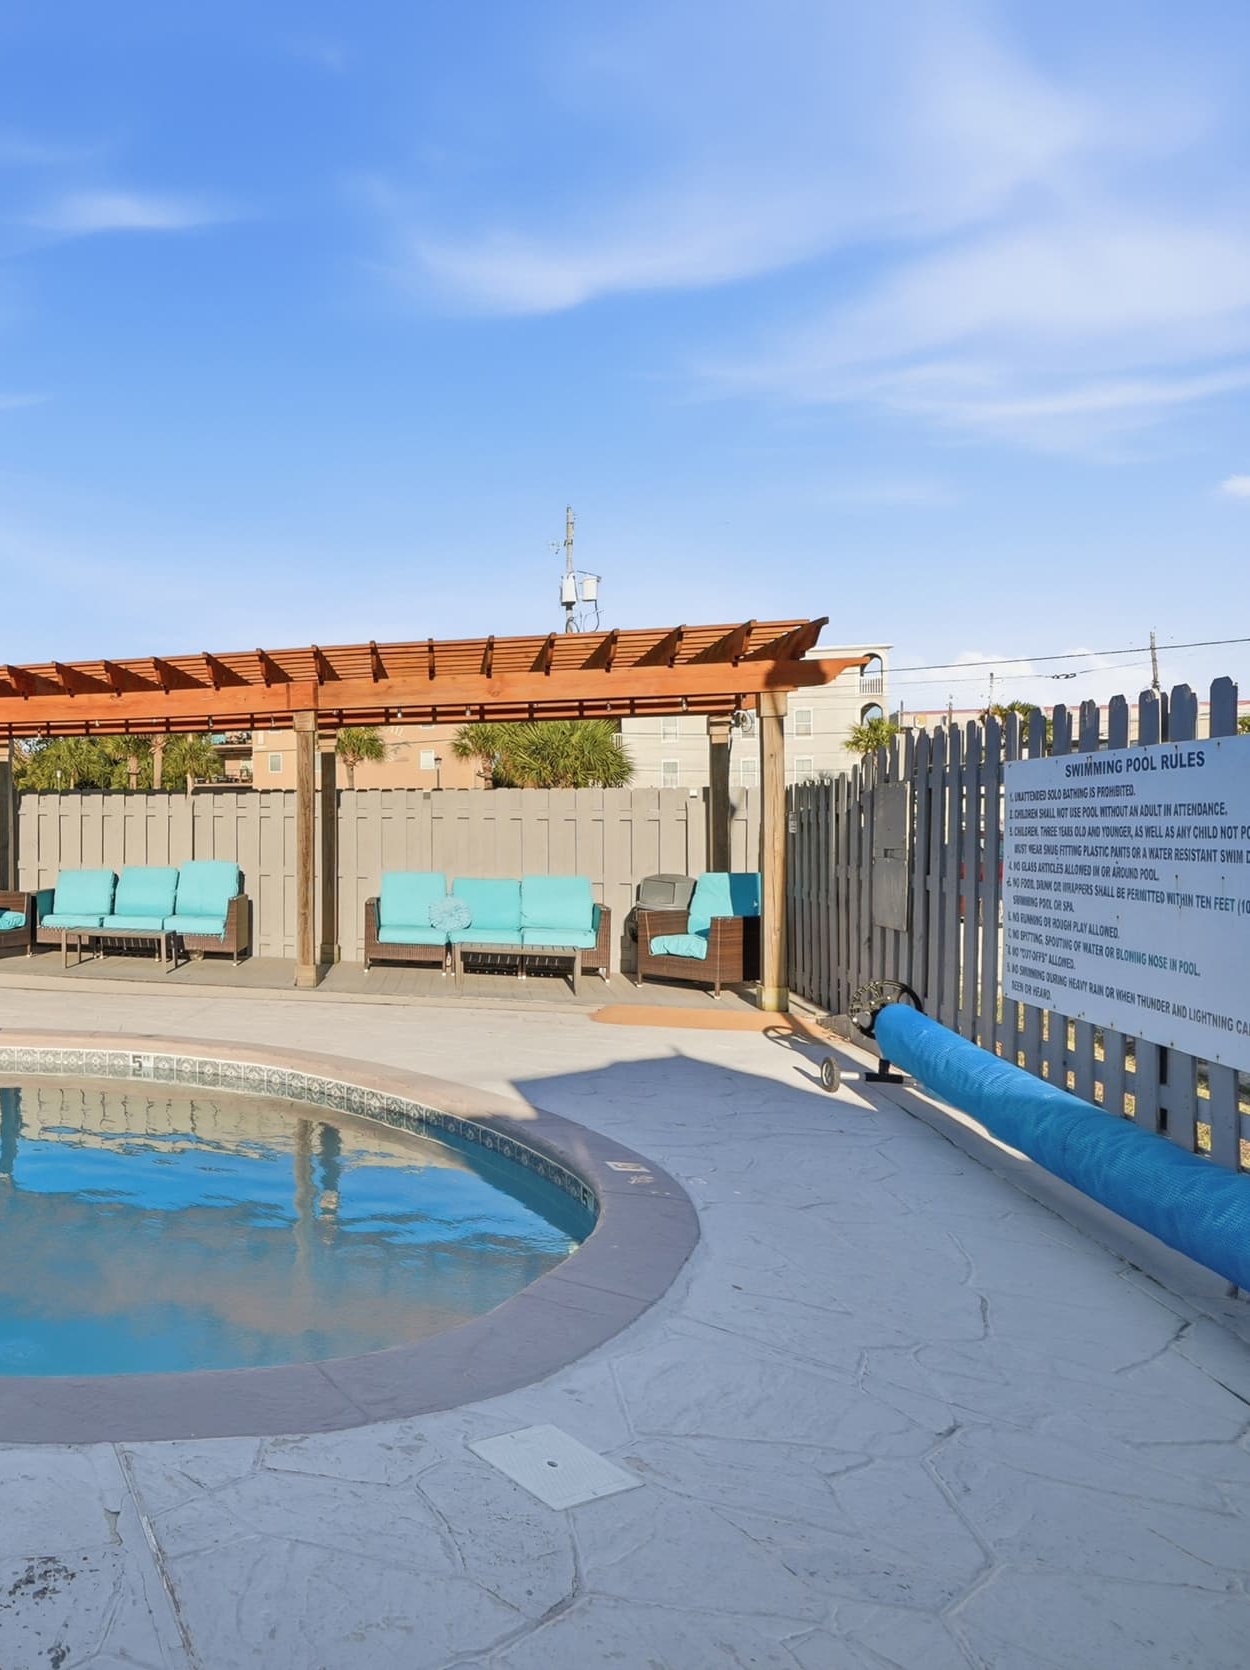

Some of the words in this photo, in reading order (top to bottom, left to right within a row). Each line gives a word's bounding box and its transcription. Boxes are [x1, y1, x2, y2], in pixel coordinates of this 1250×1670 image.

[1065, 760, 1123, 778] SWIMMING
[1126, 756, 1157, 772] POOL
[1161, 751, 1205, 770] RULES
[1048, 790, 1062, 800] SOLO
[1063, 788, 1088, 800] BATHING
[1089, 787, 1096, 798] IS
[1097, 784, 1136, 798] PROHIBITED.
[1015, 808, 1038, 819] CHILDREN
[1039, 808, 1056, 819] SHALL
[1057, 808, 1068, 818] NOT
[1070, 807, 1081, 818] USE
[1083, 806, 1098, 818] POOL
[1100, 806, 1128, 818] WITHOUT
[1130, 805, 1139, 816] AN
[1140, 804, 1162, 817] ADULT
[1164, 804, 1171, 816] IN
[1174, 802, 1227, 816] ATTENDANCE.
[1040, 826, 1058, 837] THREE
[1059, 826, 1073, 837] YEARS
[1074, 826, 1086, 837] OLD
[1088, 826, 1101, 837] AND
[1102, 825, 1133, 840] YOUNGER,
[1135, 826, 1143, 838] AS
[1145, 826, 1163, 838] WELL
[1165, 825, 1175, 838] AS
[1176, 825, 1192, 839] ANY
[1193, 825, 1218, 839] CHILD
[1220, 825, 1239, 839] NOT
[1060, 845, 1082, 856] FITTING
[1083, 845, 1109, 858] PLASTIC
[1110, 846, 1131, 858] PANTS
[1132, 847, 1141, 859] OR
[1142, 847, 1147, 859] A
[1149, 847, 1172, 860] WATER
[1174, 848, 1218, 862] RESISTANT
[1220, 849, 1243, 863] SWIM
[1014, 862, 1020, 871] NO
[1022, 862, 1037, 872] GLASS
[1038, 863, 1063, 874] ARTICLES
[1064, 864, 1090, 877] ALLOWED
[1093, 865, 1100, 877] IN
[1101, 866, 1110, 877] OR
[1112, 867, 1138, 880] AROUND
[1140, 868, 1159, 881] POOL.
[1013, 877, 1019, 888] NO
[1036, 880, 1052, 891] DRINK
[1054, 881, 1061, 892] OR
[1062, 882, 1093, 896] WRAPPERS
[1095, 885, 1114, 898] SHALL
[1117, 888, 1125, 899] BE
[1127, 888, 1165, 904] PERMITTED
[1166, 892, 1193, 908] WITHIN
[1196, 895, 1211, 909] TEN
[1214, 897, 1236, 912] FEET
[1039, 898, 1052, 910] POOL
[1054, 900, 1062, 911] OR
[1063, 901, 1074, 912] SPA.
[1013, 912, 1019, 922] NO
[1020, 913, 1042, 926] RUNNING
[1044, 917, 1051, 928] OR
[1052, 918, 1071, 932] ROUGH
[1073, 920, 1088, 933] PLAY
[1088, 923, 1119, 939] ALLOWED.
[1012, 946, 1019, 957] NO
[1048, 954, 1076, 969] ALLOWED.
[1013, 929, 1019, 939] NO
[1045, 935, 1072, 951] SPOUTING
[1074, 940, 1081, 952] OF
[1082, 942, 1104, 957] WATER
[1105, 946, 1114, 958] OR
[1116, 948, 1146, 965] BLOWING
[1148, 953, 1167, 970] NOSE
[1170, 958, 1177, 972] IN
[1179, 960, 1200, 976] POOL.
[1012, 963, 1019, 974] NO
[1020, 965, 1045, 982] SWIMMING
[1046, 972, 1067, 987] DURING
[1069, 977, 1088, 991] HEAVY
[1089, 982, 1104, 996] RAIN
[1105, 986, 1114, 999] OR
[1116, 988, 1135, 1004] WHEN
[1137, 994, 1170, 1014] THUNDER
[1172, 1003, 1187, 1018] AND
[1189, 1008, 1234, 1031] LIGHTNING
[1025, 984, 1031, 995] OR
[132, 1054, 142, 1070] 5
